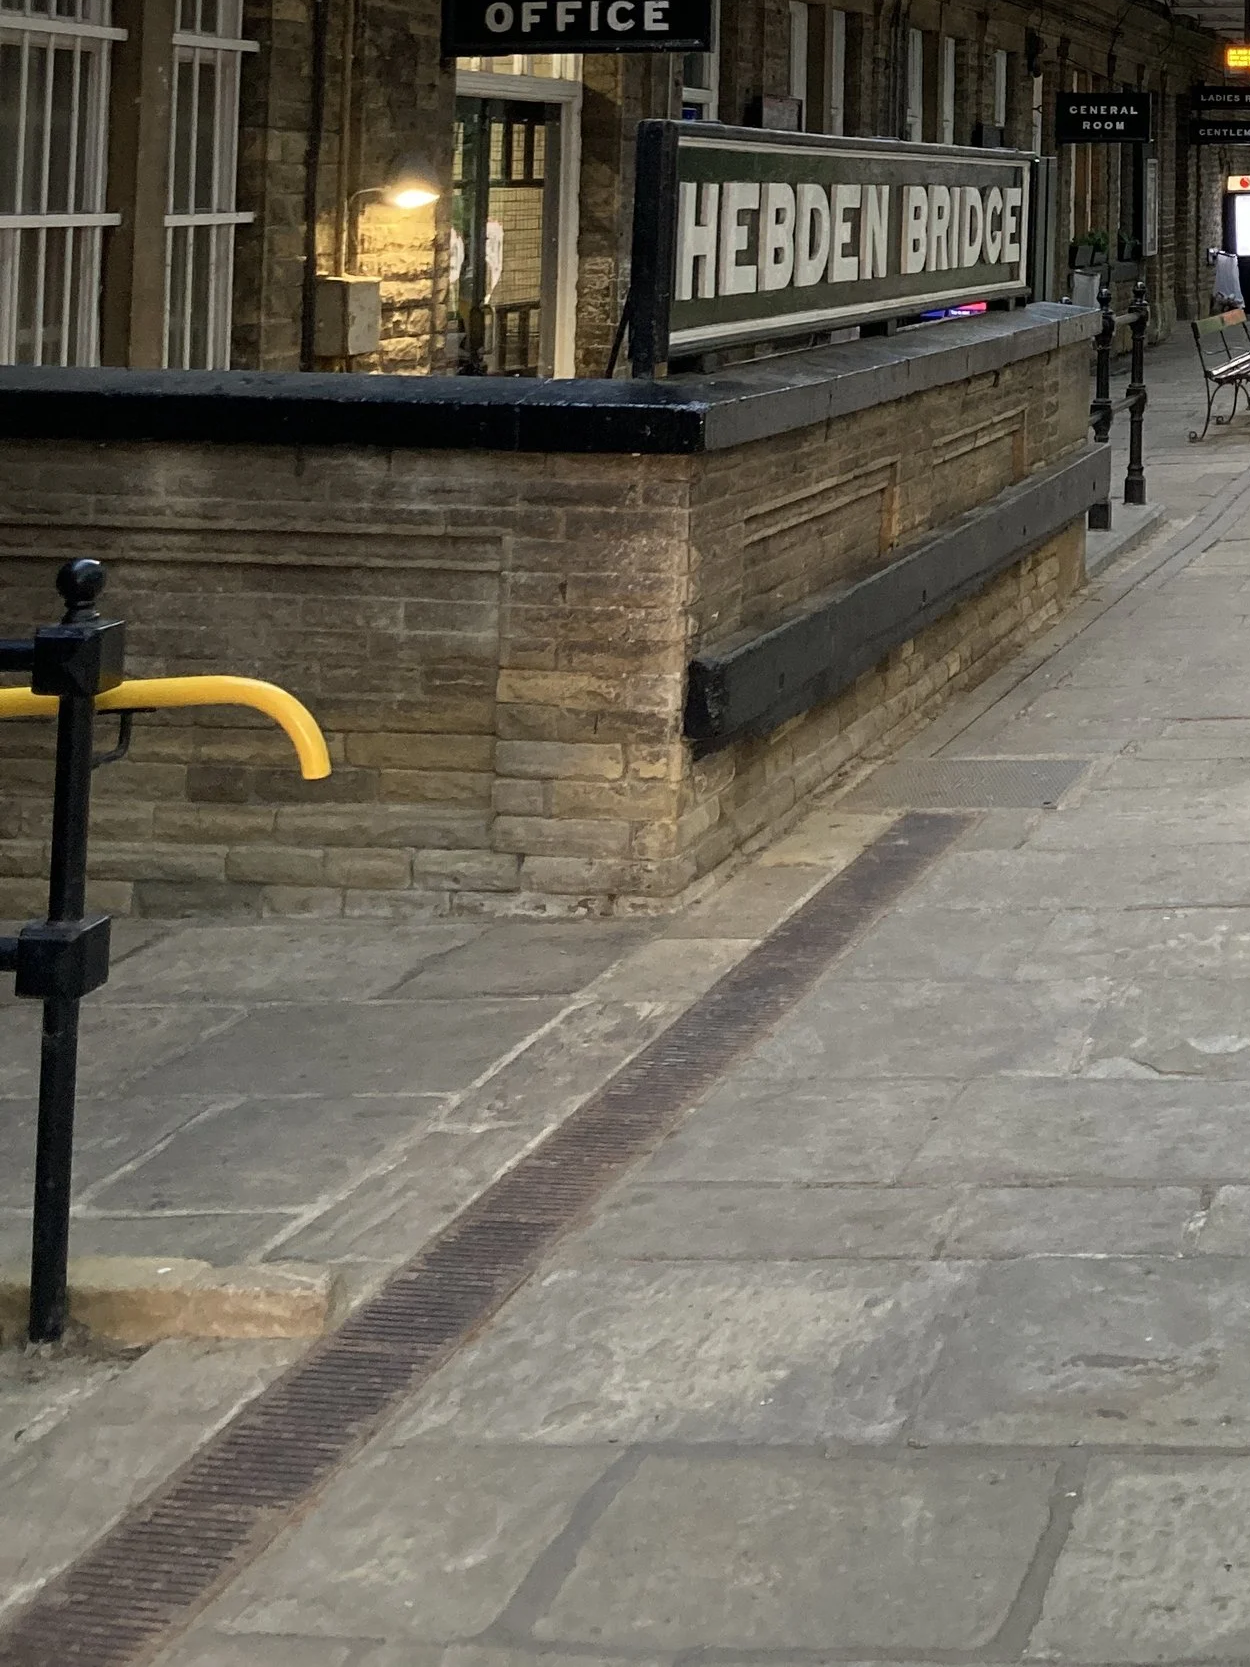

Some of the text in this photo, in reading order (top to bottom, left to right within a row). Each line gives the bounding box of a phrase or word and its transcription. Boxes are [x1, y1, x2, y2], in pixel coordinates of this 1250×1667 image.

[486, 0, 671, 33] OFFICE
[1201, 94, 1240, 102] LADIES
[1069, 105, 1138, 115] GENERAL
[1082, 121, 1125, 130] ROOM
[674, 181, 1023, 301] HEBDEN BRIDGE
